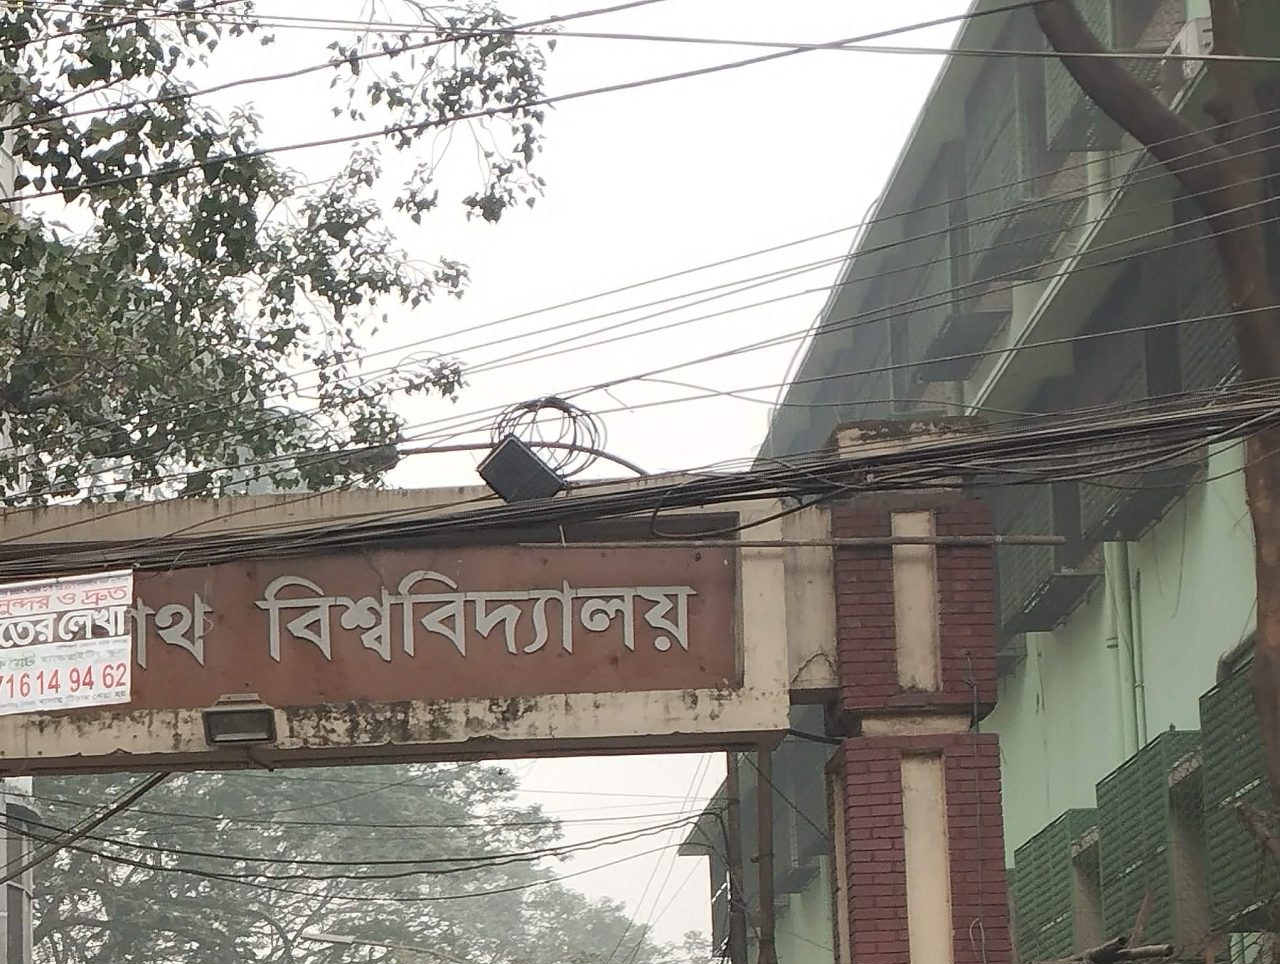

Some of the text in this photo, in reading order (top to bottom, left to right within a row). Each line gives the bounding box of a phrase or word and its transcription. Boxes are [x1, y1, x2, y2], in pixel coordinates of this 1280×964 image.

[57, 592, 76, 606] ও
[81, 586, 128, 606] দ্রুত
[58, 606, 128, 641] লেখা
[255, 569, 696, 663] বিশ্ববিদ্যালয়
[70, 665, 95, 692] 94
[102, 662, 127, 689] 62
